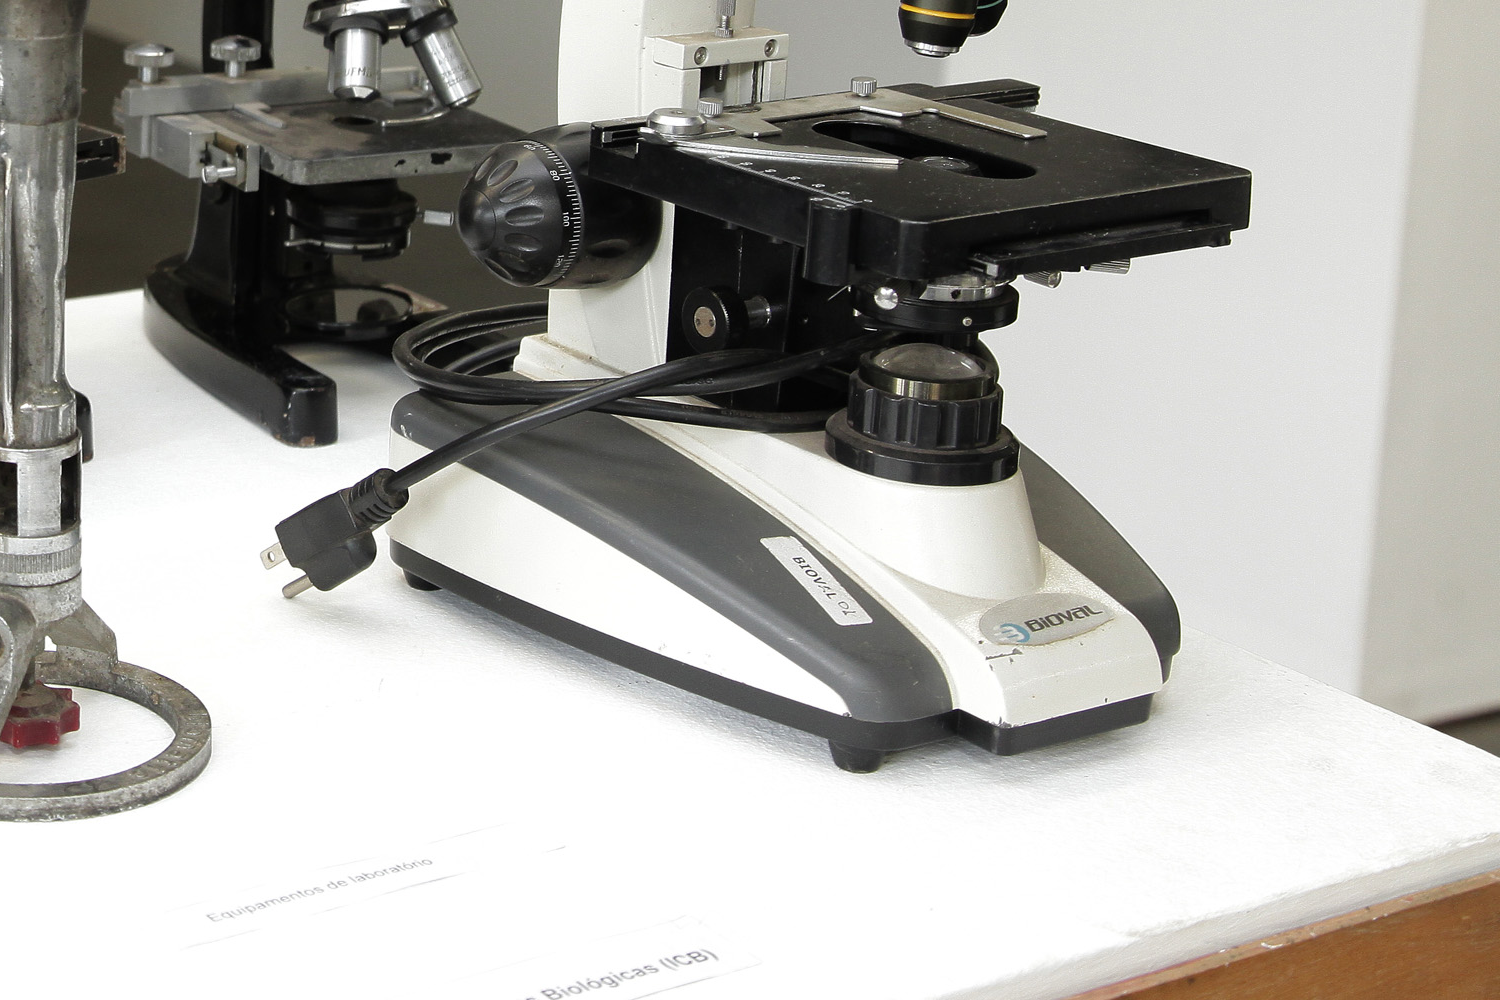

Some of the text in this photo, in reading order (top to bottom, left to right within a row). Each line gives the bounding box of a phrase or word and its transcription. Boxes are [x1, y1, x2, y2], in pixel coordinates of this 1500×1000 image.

[549, 169, 561, 182] 80
[562, 211, 571, 228] 100
[792, 555, 838, 601] BIOVAL
[205, 857, 434, 923] Equipamentos de laboratório
[540, 948, 720, 1000] Biológicas (ICB)
